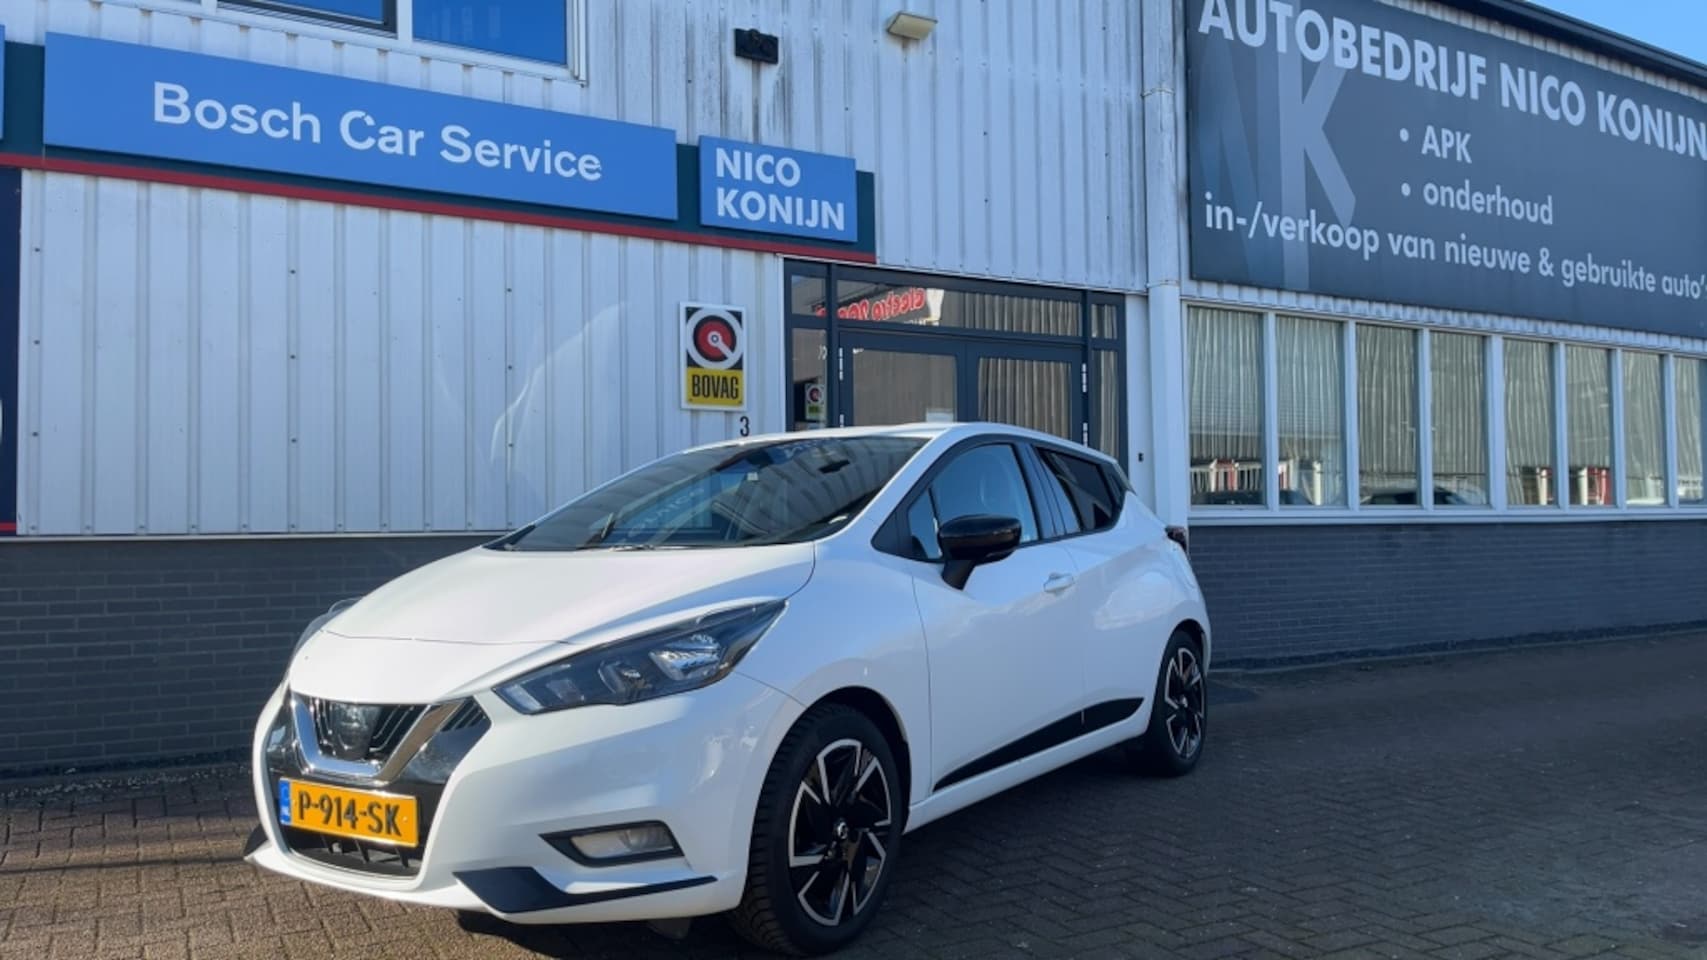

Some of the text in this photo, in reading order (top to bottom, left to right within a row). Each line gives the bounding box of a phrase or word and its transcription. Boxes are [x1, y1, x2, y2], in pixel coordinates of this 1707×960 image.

[1198, 0, 1707, 161] AUTOBEDRIJF NICO KONIJN
[154, 81, 602, 180] Bosch Car Service
[1421, 125, 1472, 164] APK
[716, 148, 800, 187] NICO
[717, 187, 845, 231] KONIJN
[1423, 179, 1553, 225] onderhoud
[1205, 191, 1707, 299] in-/verkoop van nieuwe & gebruikte auto'
[692, 374, 739, 399] BOVAG
[740, 416, 750, 437] 3
[298, 791, 401, 836] P-914-SK
